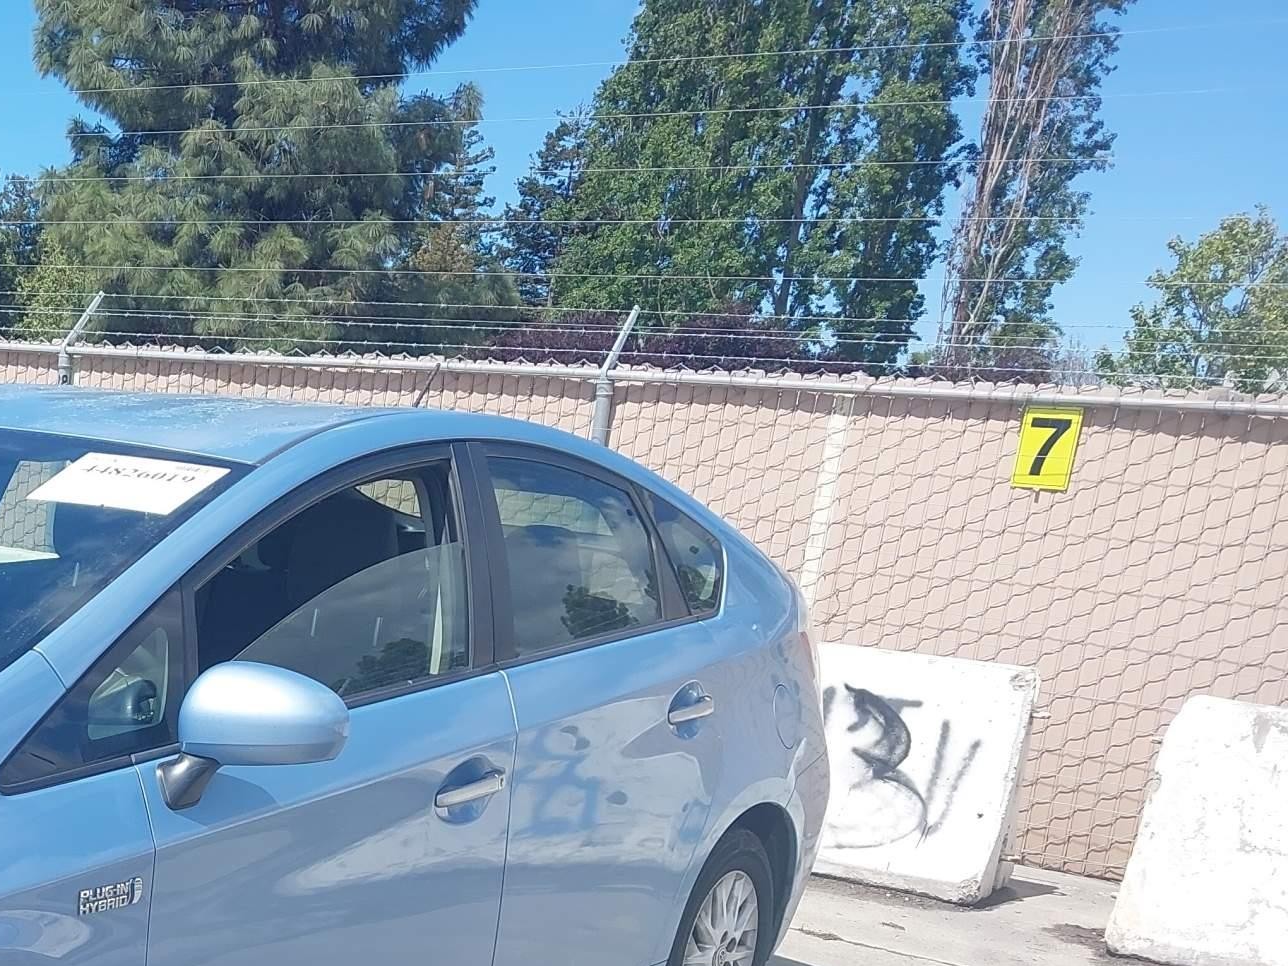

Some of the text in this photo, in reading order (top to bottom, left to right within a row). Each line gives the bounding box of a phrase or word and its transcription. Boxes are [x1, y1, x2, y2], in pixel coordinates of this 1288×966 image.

[1028, 417, 1072, 476] 7
[80, 882, 129, 902] PLUG-IN
[79, 895, 128, 916] HYBRID
